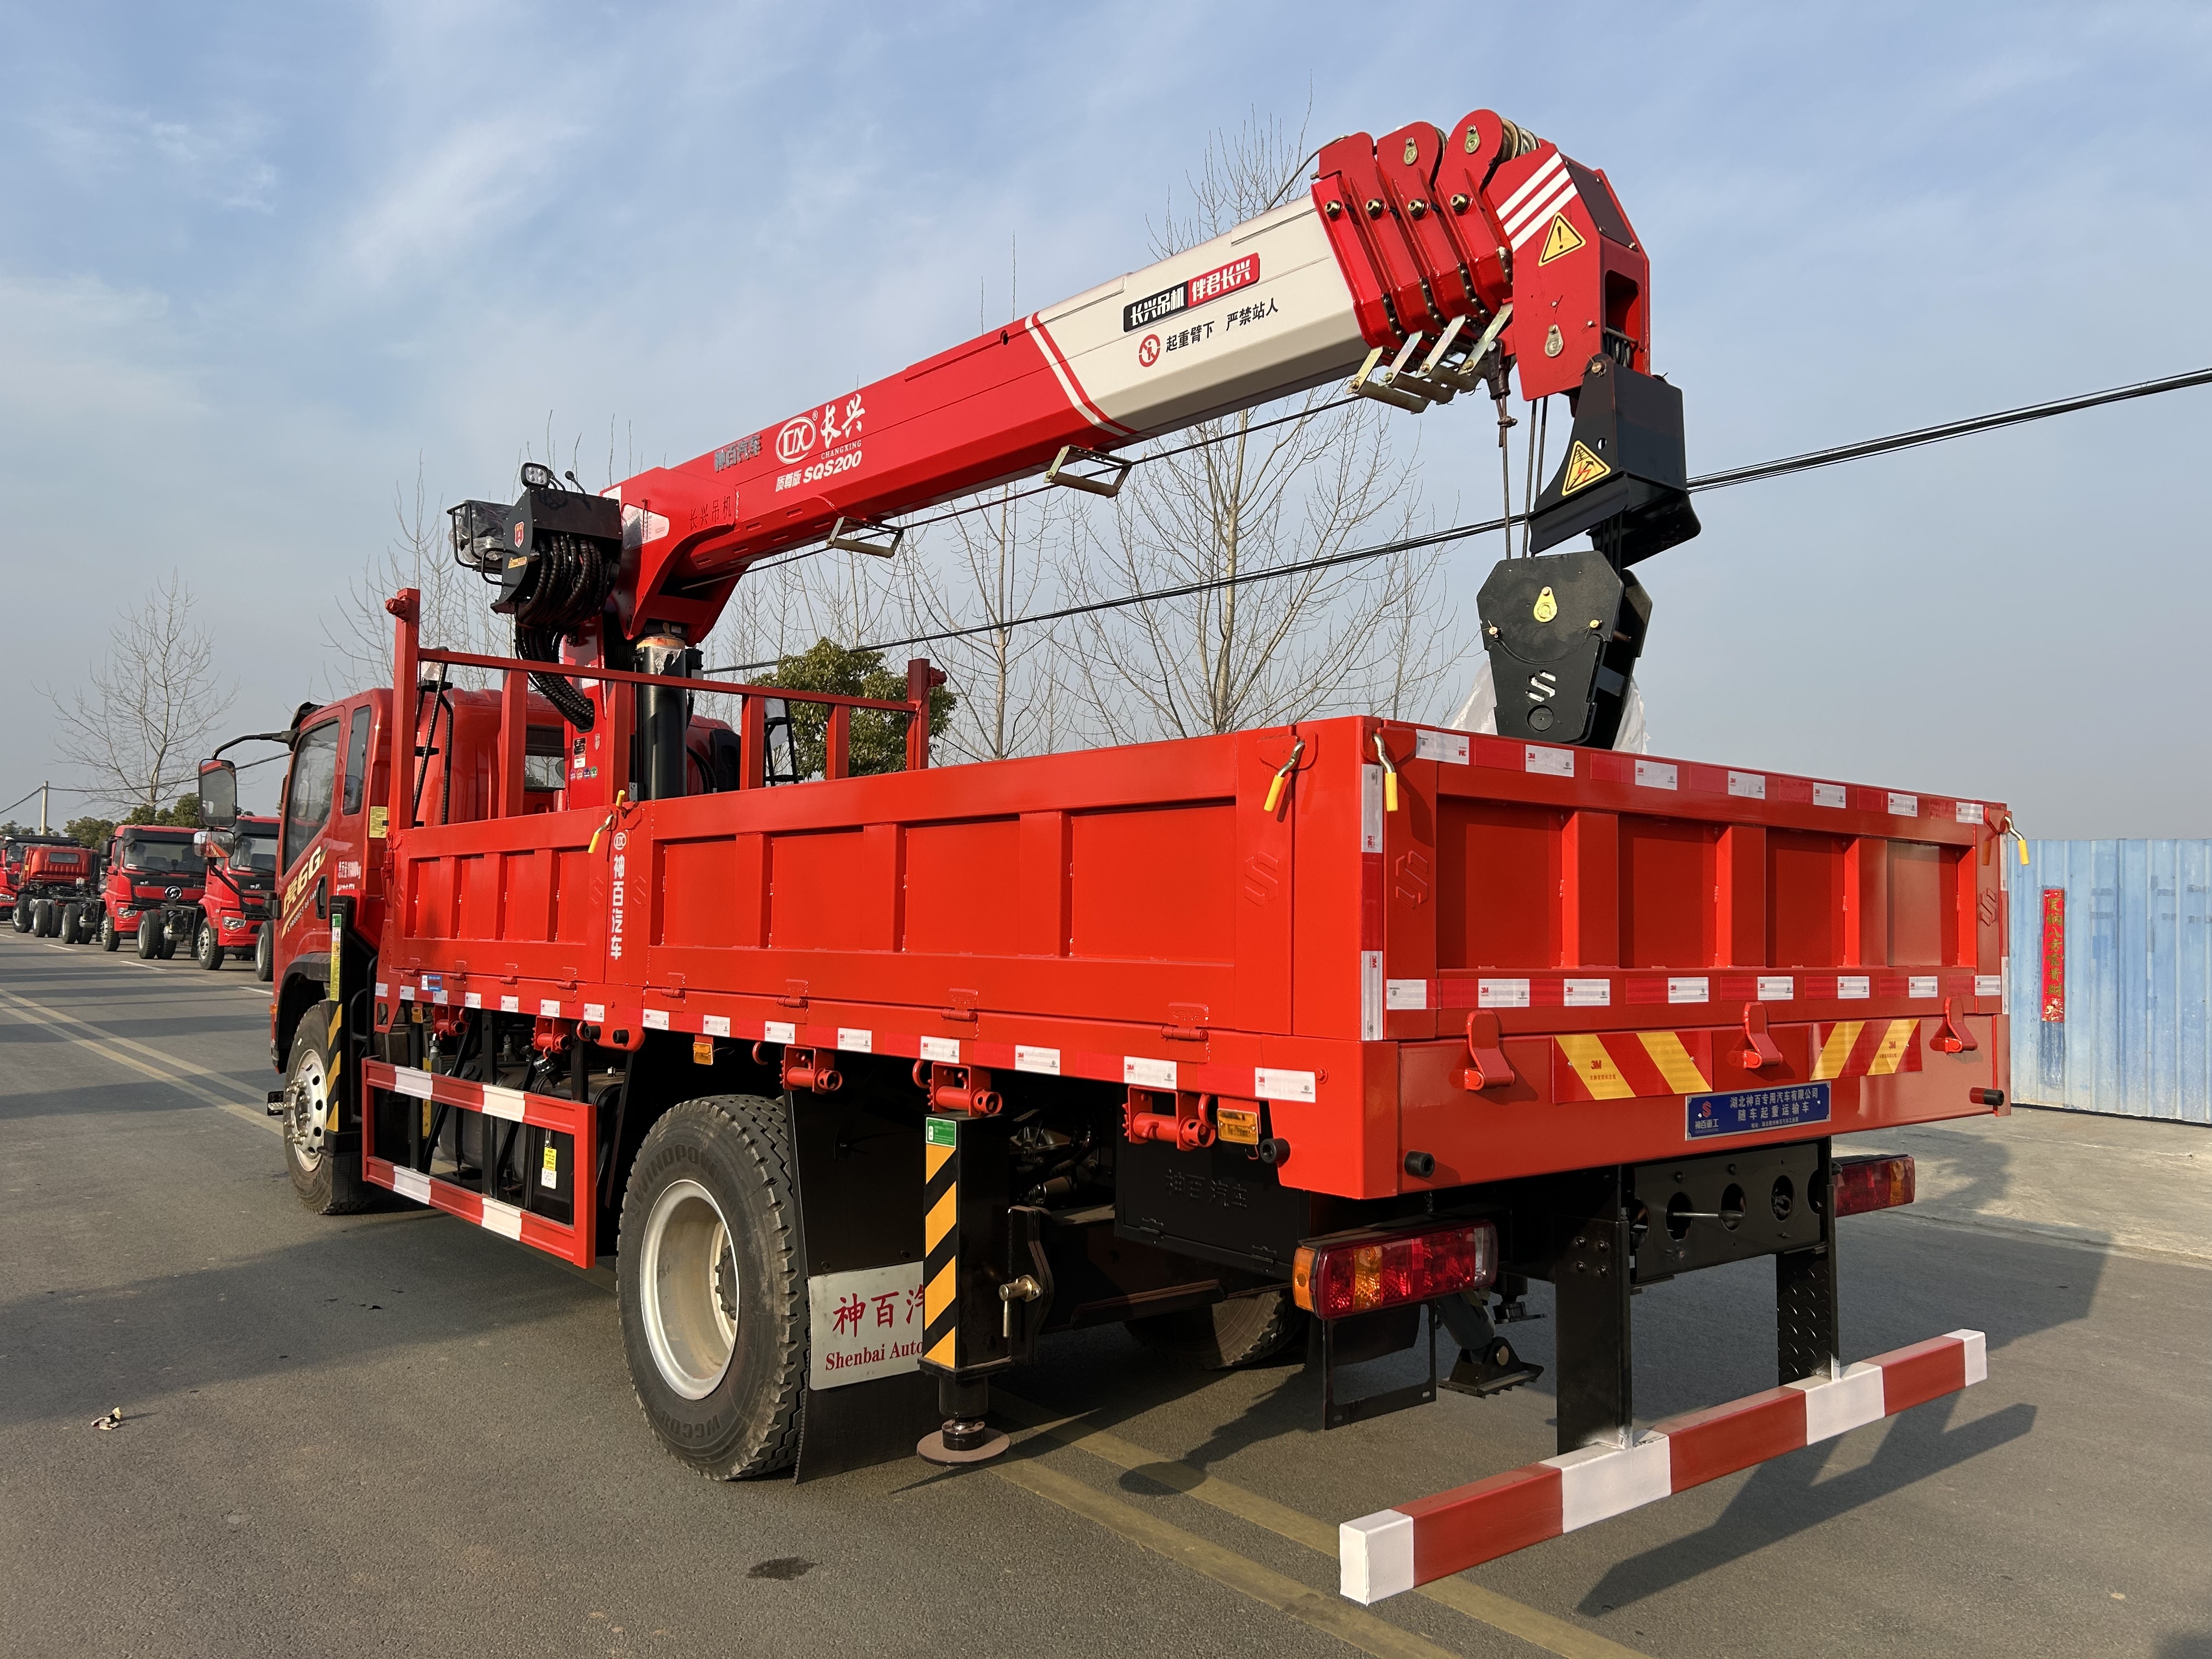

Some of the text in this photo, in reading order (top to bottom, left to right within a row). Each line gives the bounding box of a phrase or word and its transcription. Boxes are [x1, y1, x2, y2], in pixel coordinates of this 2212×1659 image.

[1131, 259, 1251, 327] 长兴吊机 伴君长兴
[1166, 297, 1278, 353] 起重臂下 严禁站人
[821, 393, 866, 449] 长兴
[715, 435, 762, 473] 神百汽车
[821, 439, 862, 460] CHANGXING
[803, 450, 862, 483] SQS200
[689, 495, 732, 532] 长兴吊机
[290, 906, 304, 929] PRODUCT
[611, 854, 625, 960] 神百汽车
[1372, 955, 1377, 968] 3M
[1590, 1059, 1602, 1070] 3M
[1730, 1087, 1819, 1108] 湖北神百专用汽车有限公司
[1738, 1101, 1809, 1122] 随车起重运输车
[1165, 1169, 1248, 1208] 神百汽车
[825, 1344, 885, 1371] Shenbai
